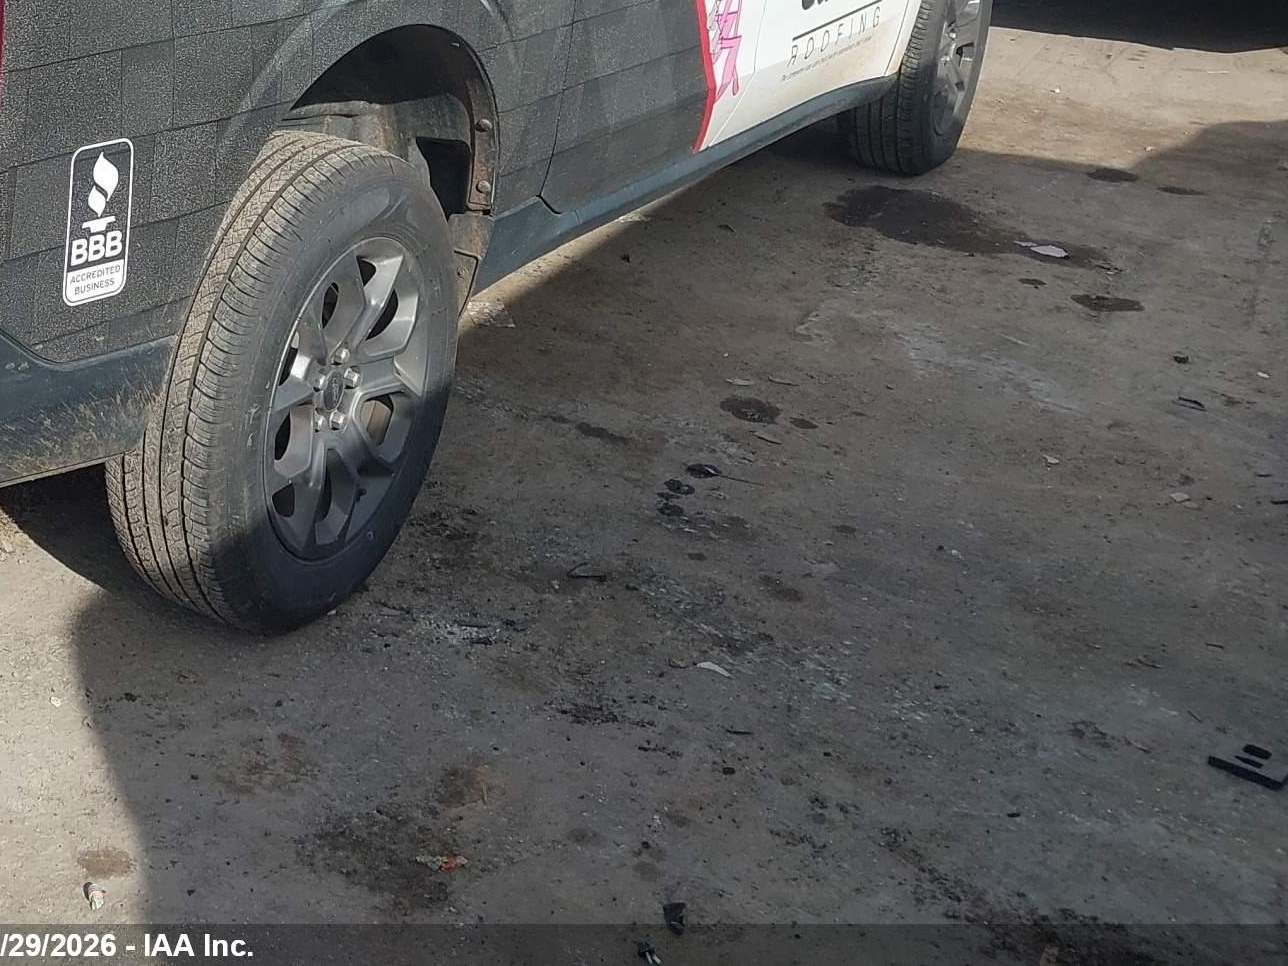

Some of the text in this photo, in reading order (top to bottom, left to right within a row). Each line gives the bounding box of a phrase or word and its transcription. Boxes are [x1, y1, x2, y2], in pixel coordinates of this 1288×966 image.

[787, 6, 882, 67] ROOFING
[70, 230, 123, 266] BBB
[70, 264, 121, 284] ACCREDITED
[74, 278, 115, 296] BUSINESS
